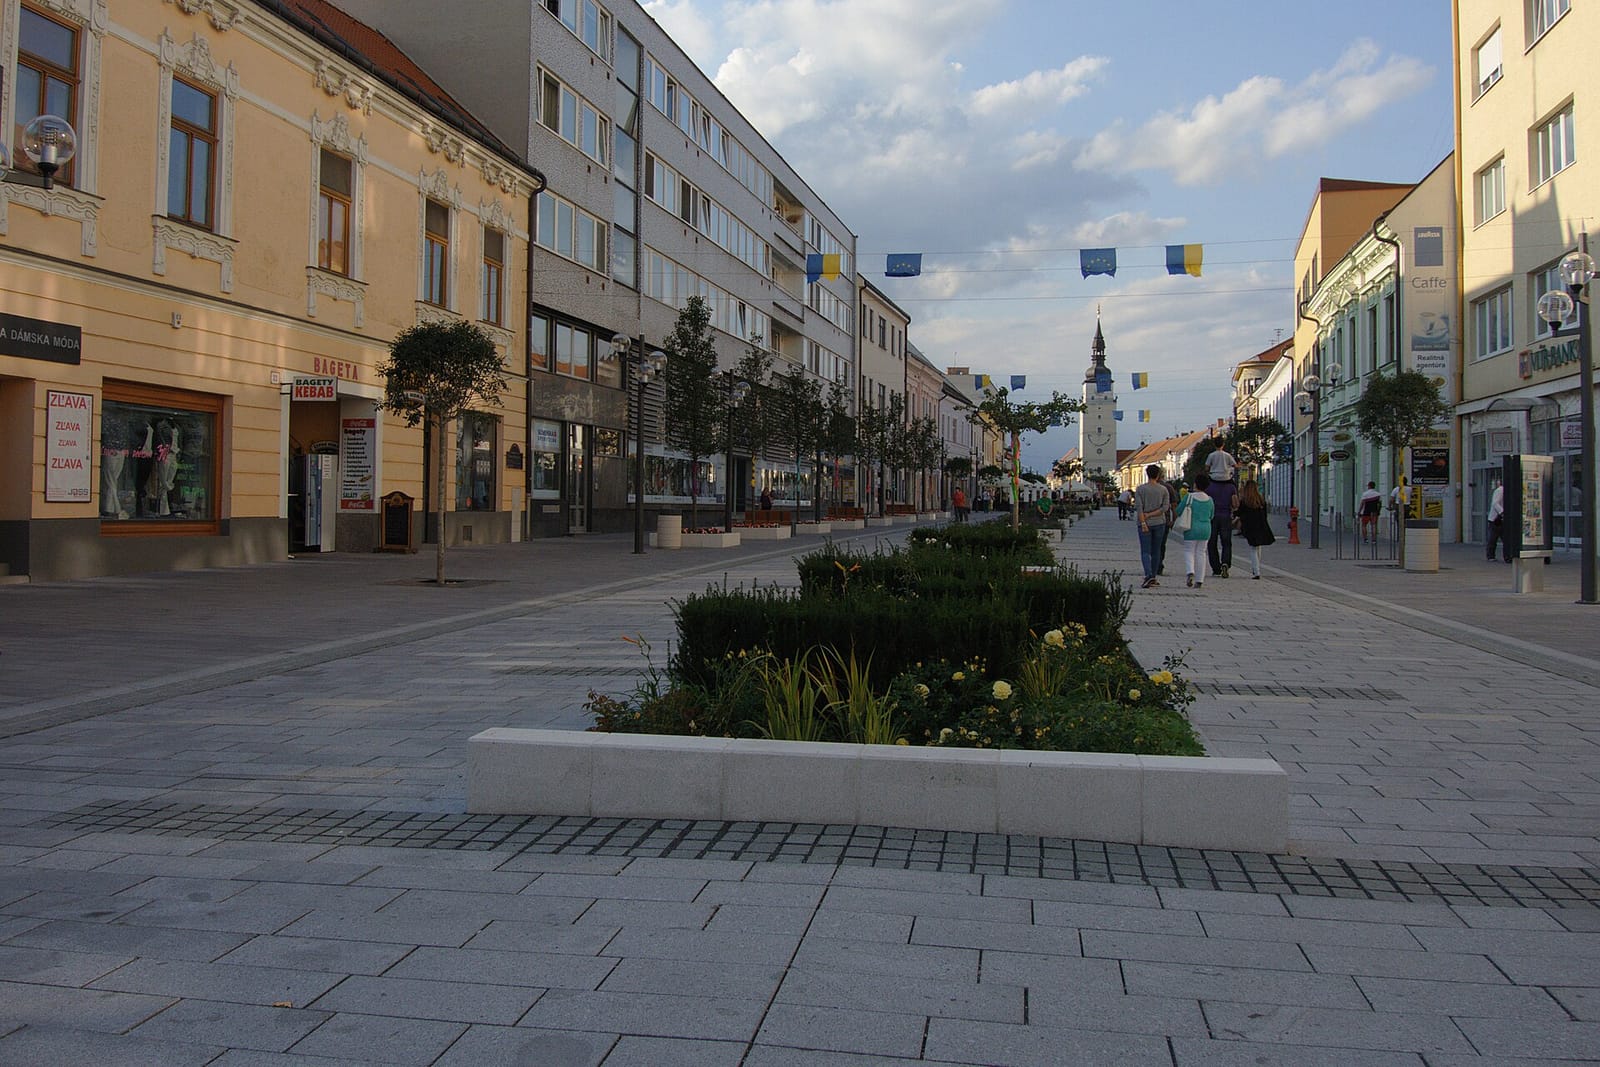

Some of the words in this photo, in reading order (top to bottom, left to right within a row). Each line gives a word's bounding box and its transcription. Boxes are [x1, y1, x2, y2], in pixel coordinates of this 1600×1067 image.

[1411, 276, 1447, 289] Caffe
[10, 328, 50, 345] DÁMSKA
[53, 336, 81, 350] MÓDA
[314, 357, 358, 380] BAGETA
[295, 386, 334, 398] KEBAB
[50, 394, 87, 409] ZĽAVA
[56, 421, 80, 431] ZĽAVA
[51, 458, 83, 469] ZĽAVA
